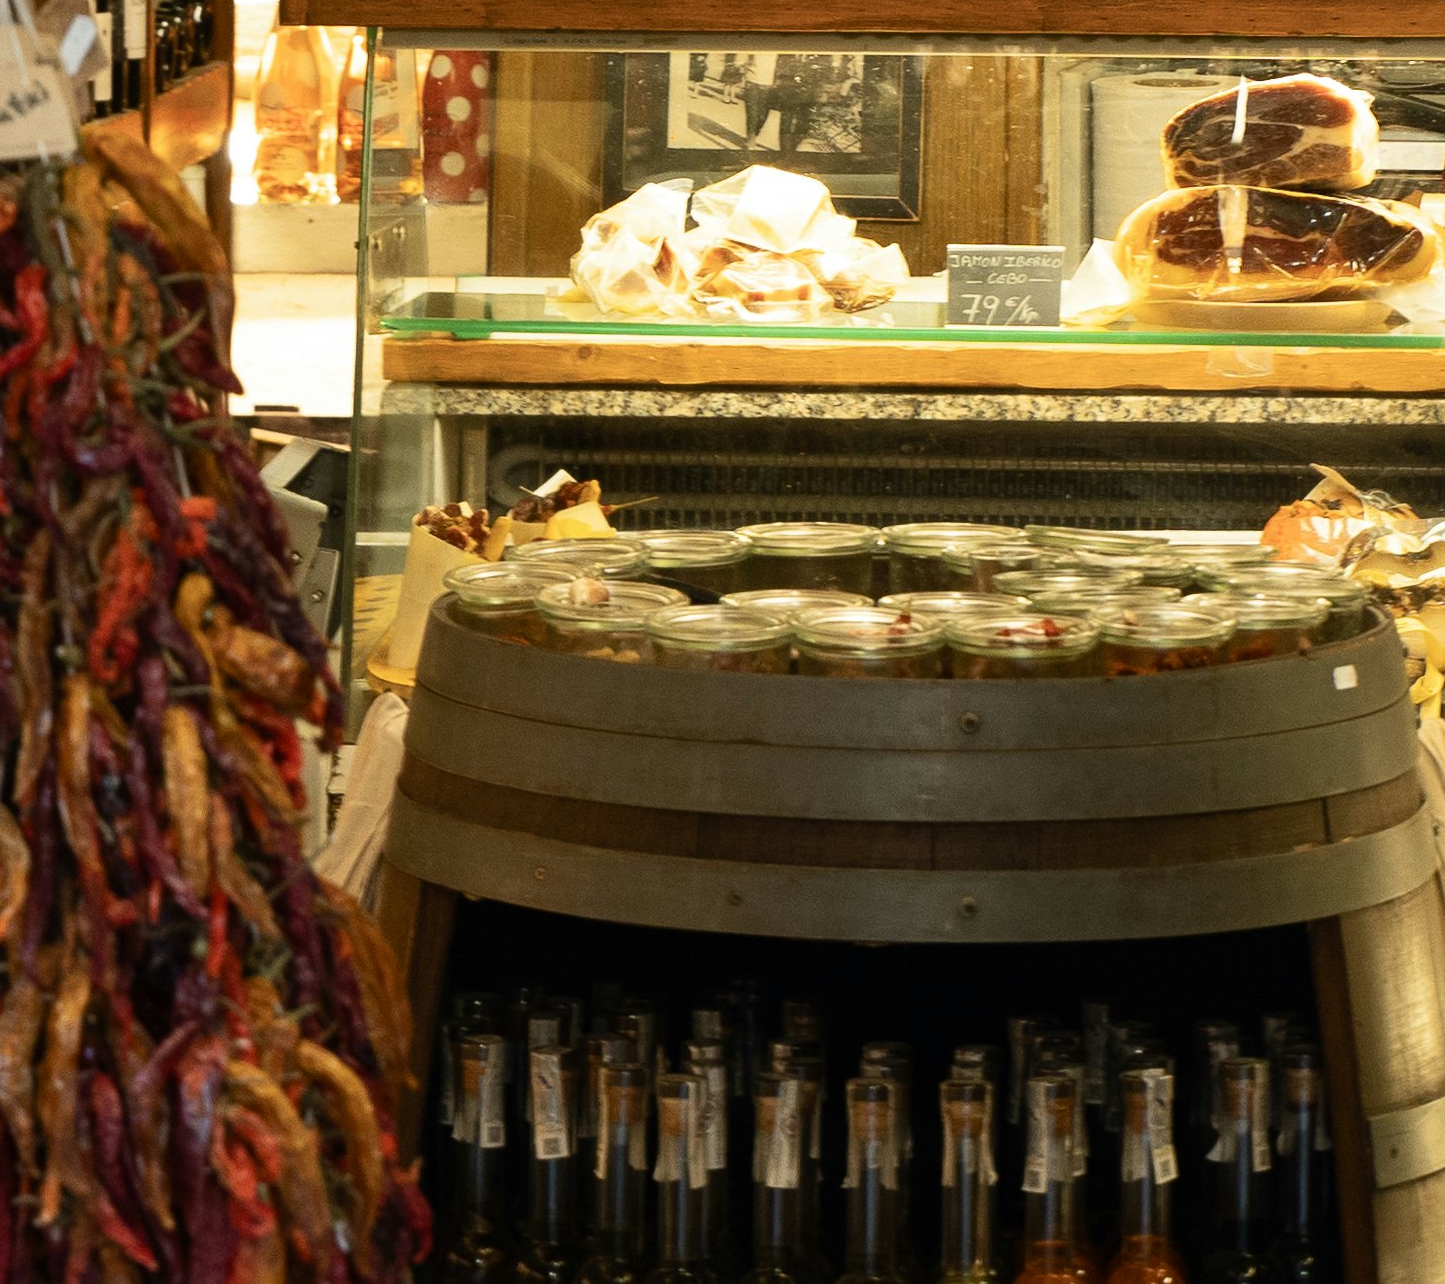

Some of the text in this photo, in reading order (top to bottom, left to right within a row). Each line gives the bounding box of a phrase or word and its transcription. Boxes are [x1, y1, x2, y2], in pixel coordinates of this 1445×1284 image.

[948, 254, 1000, 268] JAMON
[987, 272, 1029, 285] CEBO
[959, 293, 1001, 325] 79
